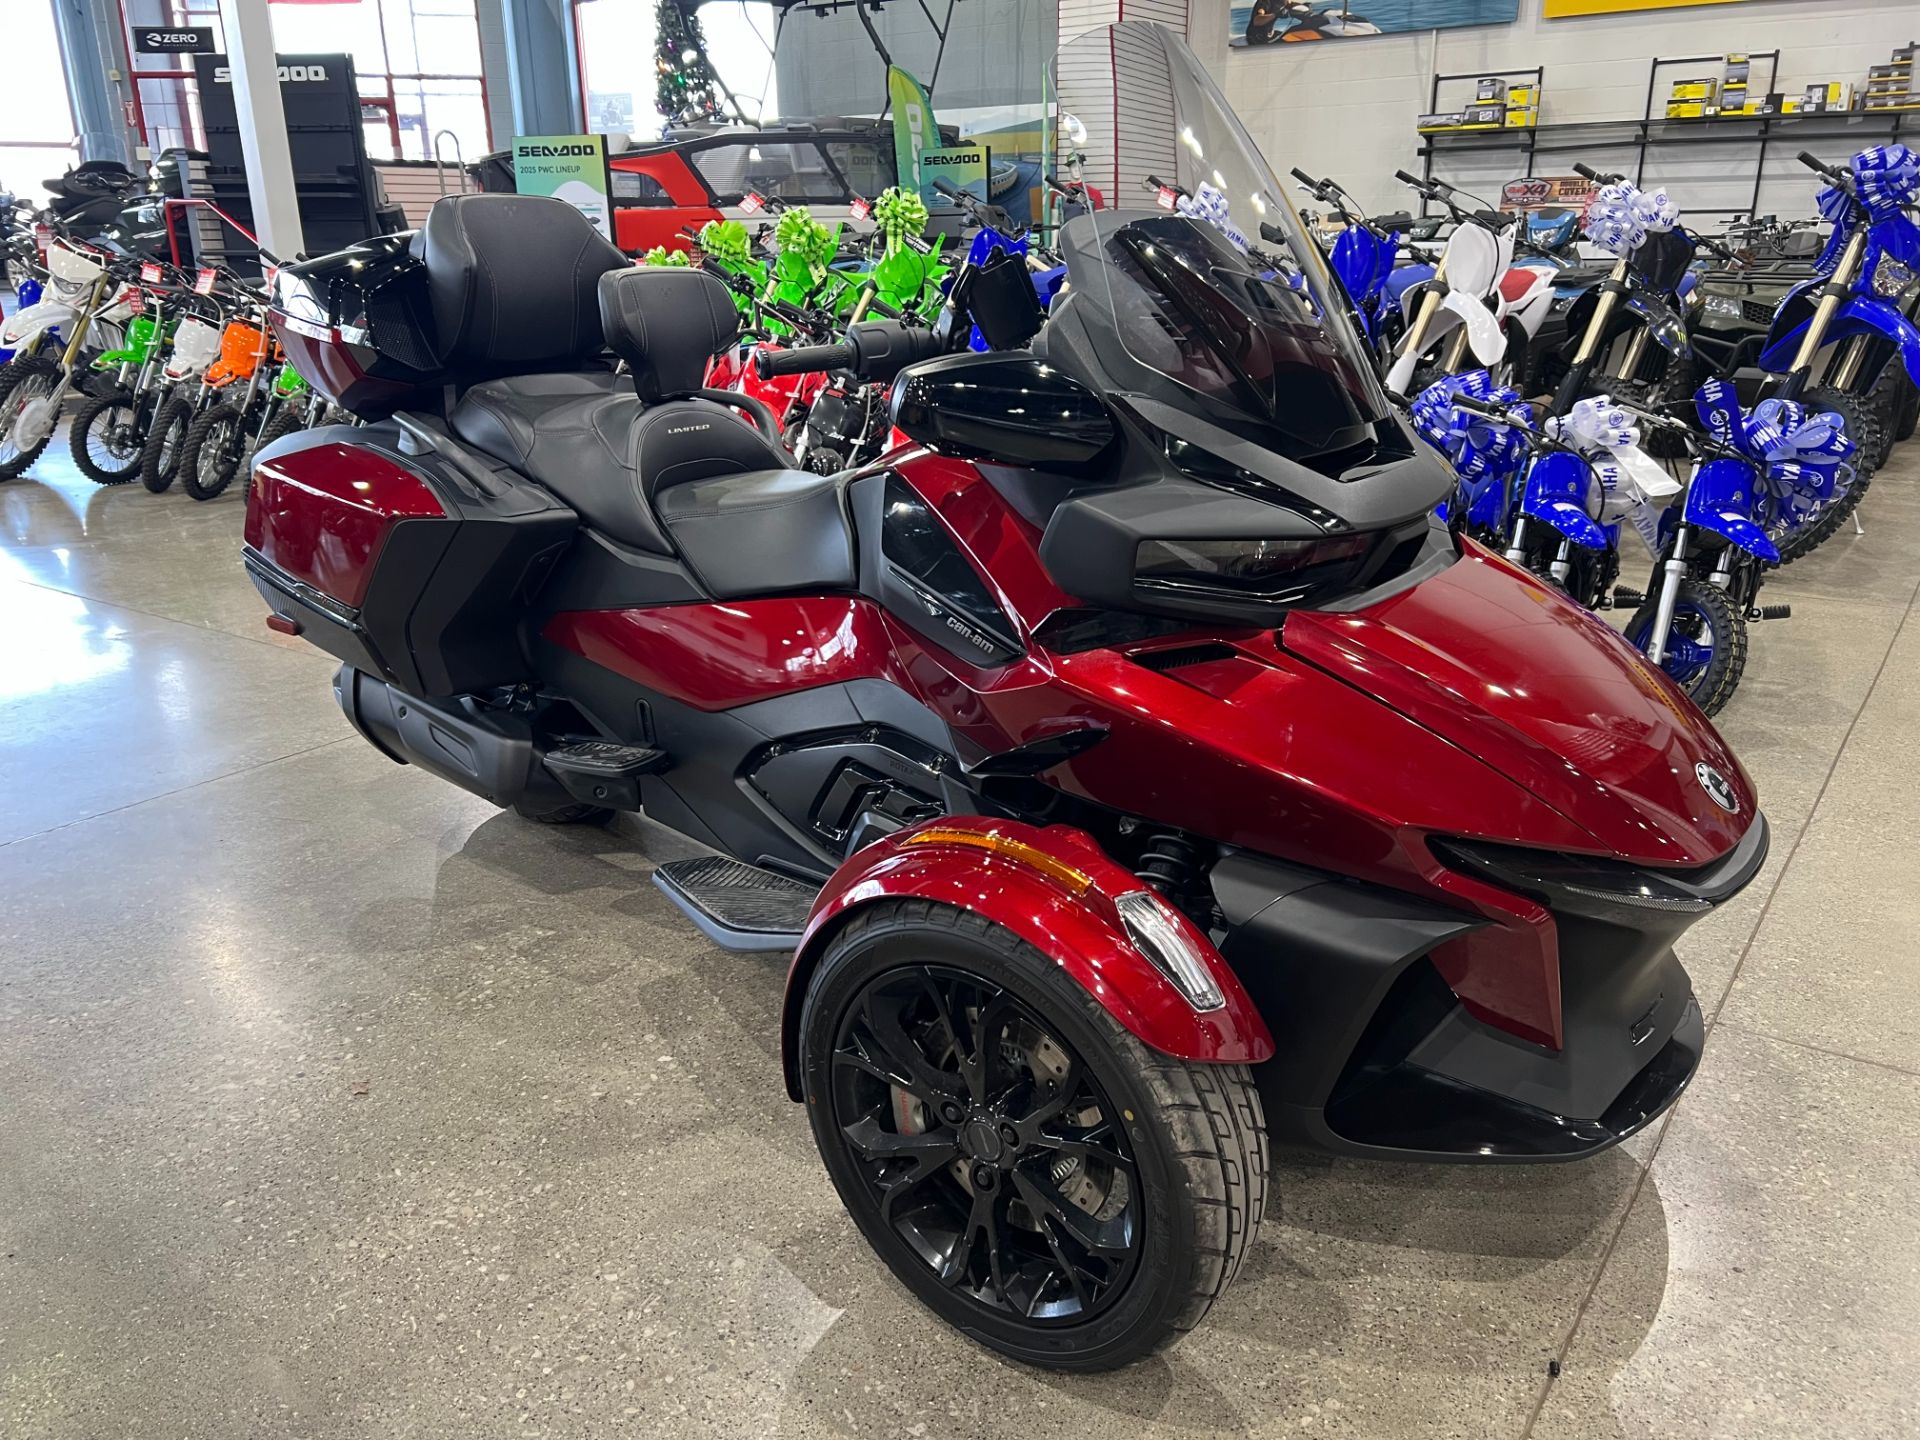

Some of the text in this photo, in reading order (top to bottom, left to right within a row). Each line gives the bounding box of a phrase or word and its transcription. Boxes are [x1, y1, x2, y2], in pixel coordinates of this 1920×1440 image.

[162, 34, 198, 43] ZERO
[520, 165, 581, 174] 2025 PWC LINEUP
[668, 424, 710, 434] LIMITED
[946, 616, 995, 653] can-am
